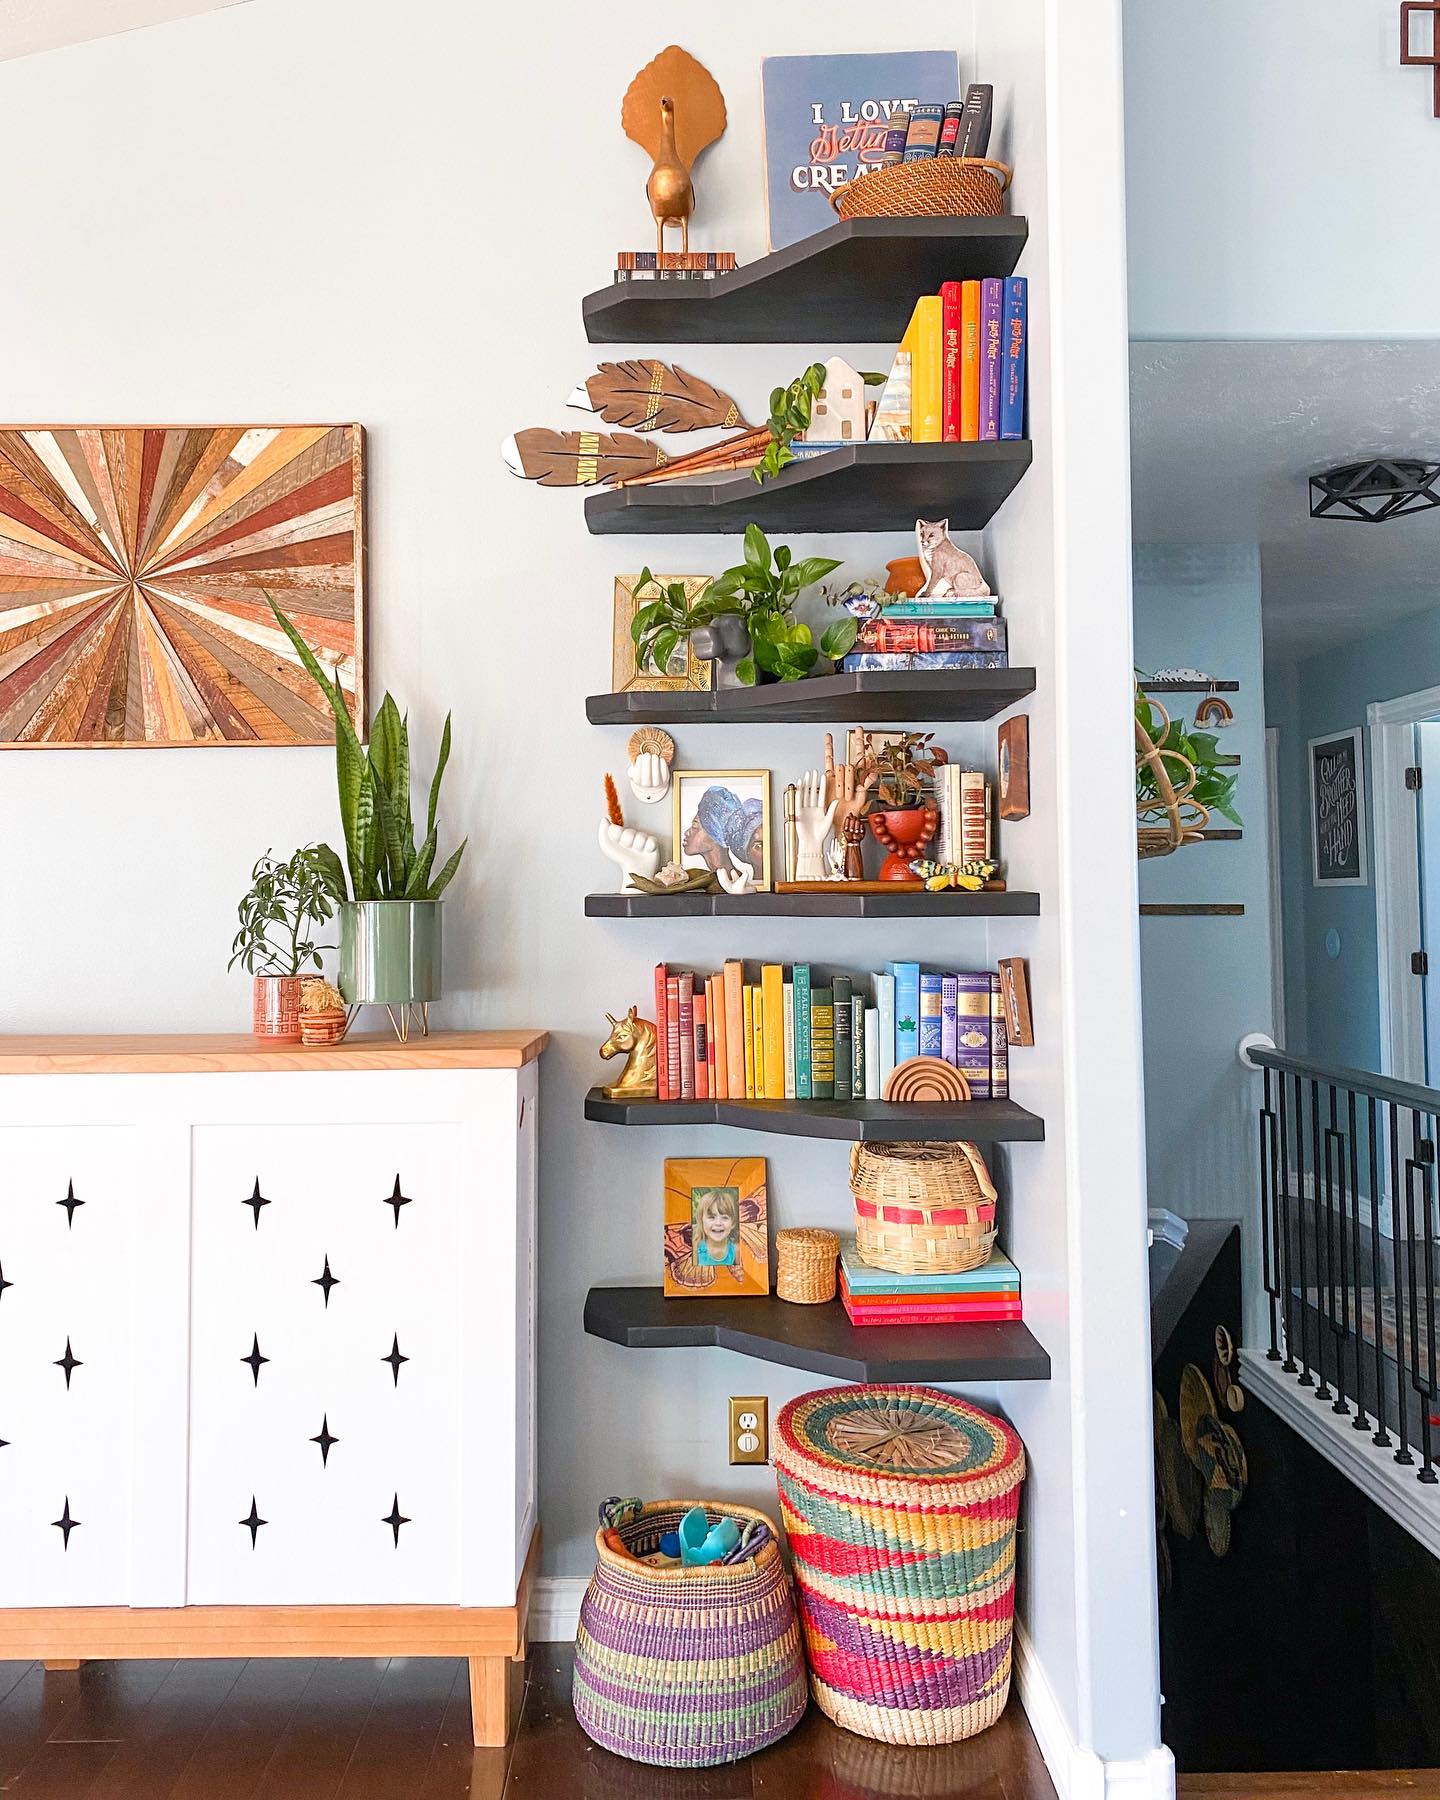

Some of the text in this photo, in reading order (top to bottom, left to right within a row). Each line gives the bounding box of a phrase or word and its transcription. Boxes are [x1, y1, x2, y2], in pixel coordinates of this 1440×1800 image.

[811, 103, 824, 124] I
[946, 328, 958, 347] Harry
[987, 319, 1000, 338] Harry
[1010, 318, 1023, 338] Harry
[946, 347, 958, 369] Potter
[987, 338, 1000, 360] Potter
[1010, 338, 1023, 360] Potter
